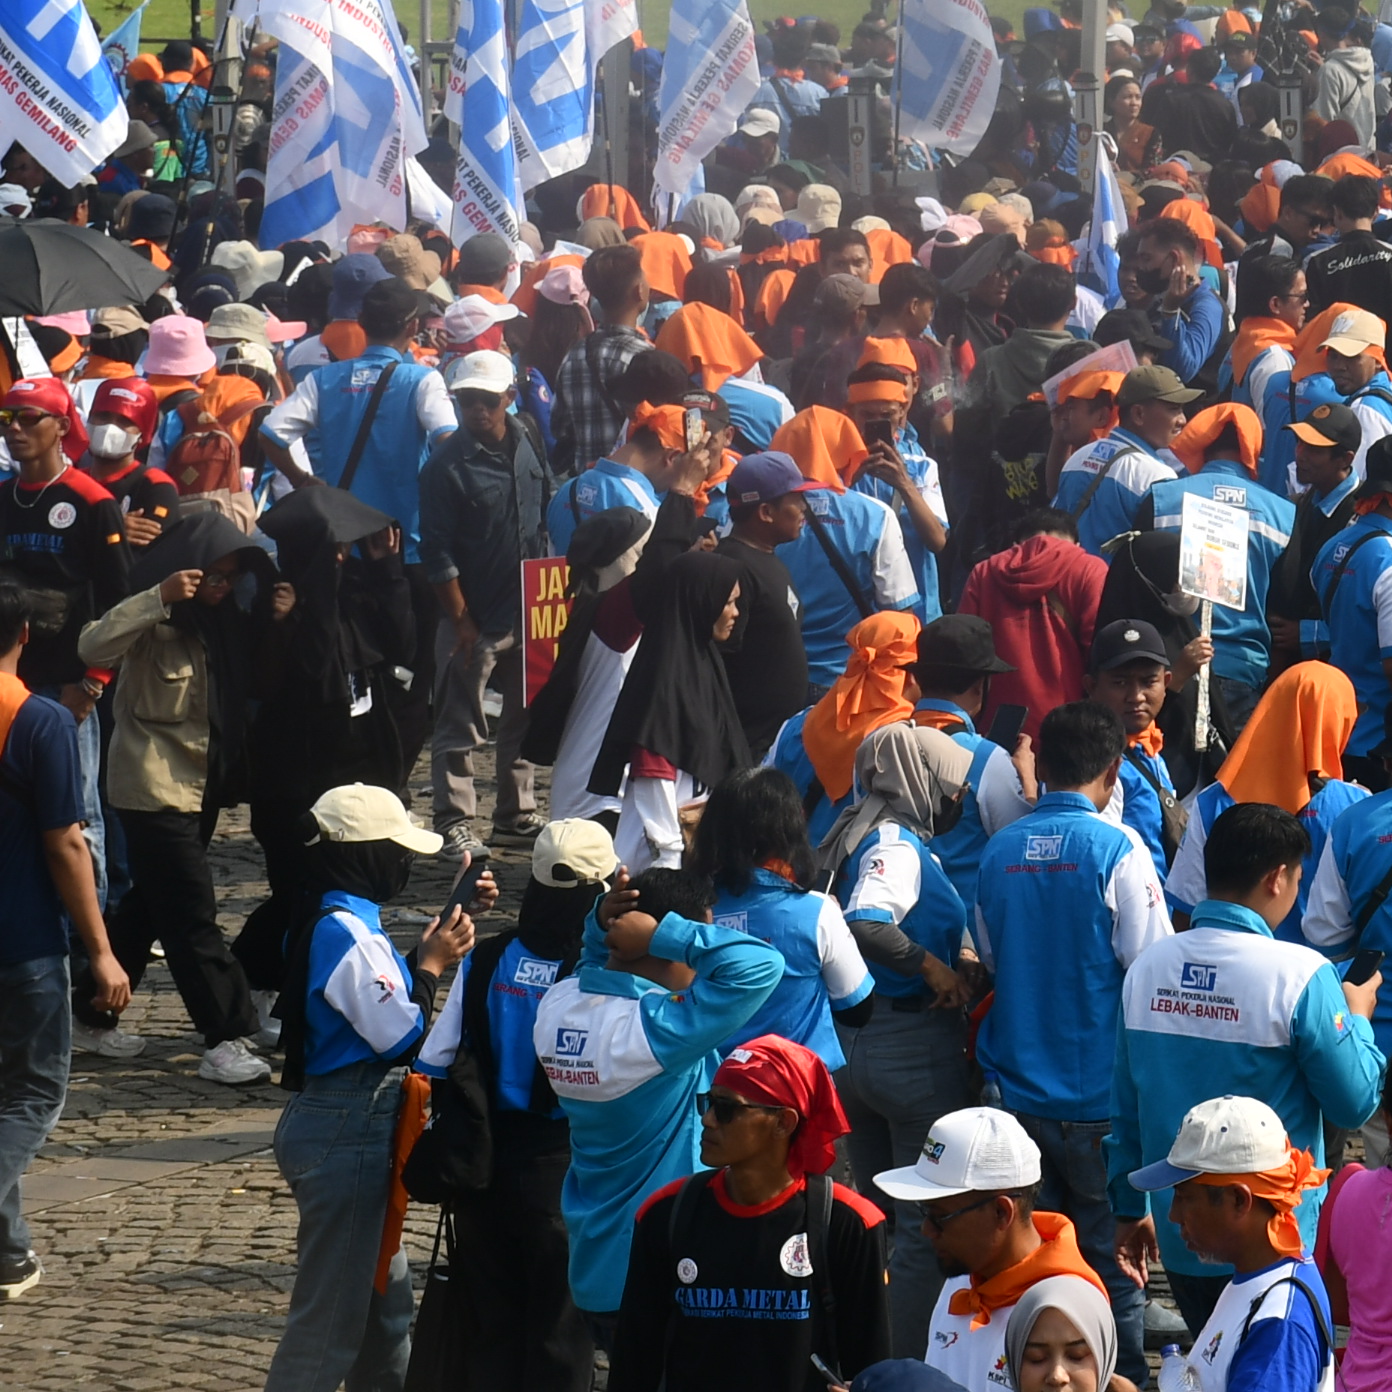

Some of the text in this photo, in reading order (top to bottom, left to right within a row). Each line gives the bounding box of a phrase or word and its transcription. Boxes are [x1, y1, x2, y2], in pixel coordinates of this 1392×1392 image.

[12, 56, 91, 139] PEKERJA NASIONAL
[15, 90, 78, 153] GEMILANG
[463, 166, 501, 217] PEKERJA
[1214, 486, 1246, 506] SPN
[1027, 835, 1063, 860] SPN
[516, 958, 558, 985] SPN
[1181, 962, 1218, 991] SPN
[1156, 987, 1181, 998] SERIKAT
[1208, 994, 1236, 1006] NASIONAL
[1150, 997, 1240, 1023] LEBAK-BANTEN
[675, 1286, 811, 1310] GARDA METAL
